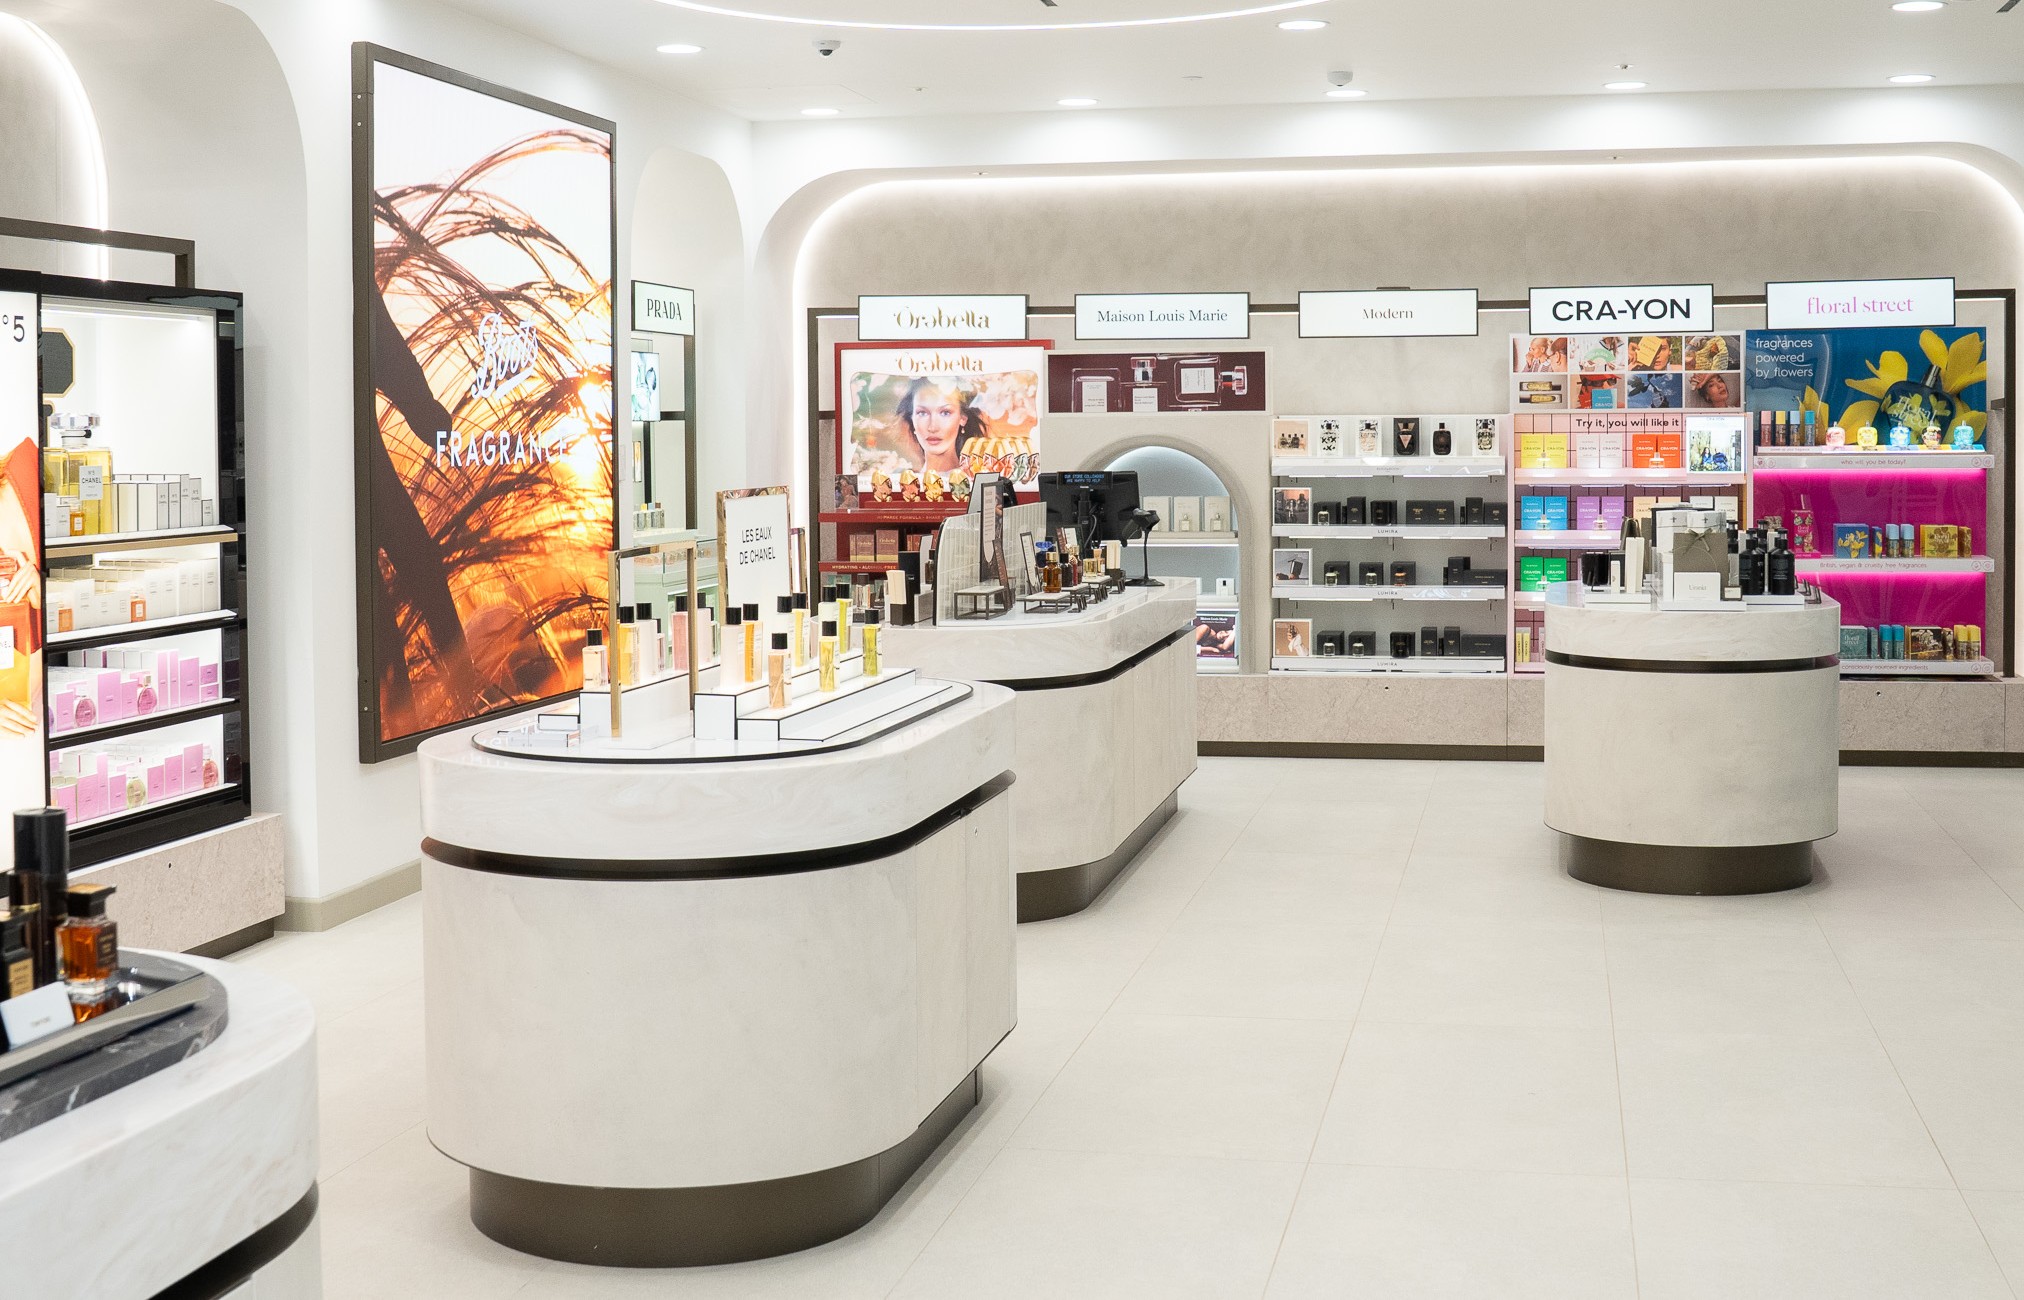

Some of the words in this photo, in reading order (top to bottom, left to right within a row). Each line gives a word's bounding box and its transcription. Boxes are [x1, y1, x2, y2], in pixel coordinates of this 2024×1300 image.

[647, 298, 682, 321] PRADA
[1363, 308, 1413, 319] Modern
[1552, 298, 1691, 322] CRA-YON
[1807, 296, 1857, 314] floral
[1863, 298, 1914, 313] street
[1097, 310, 1145, 322] Maison
[1150, 309, 1185, 322] Louis
[1189, 309, 1228, 322] Marie
[1755, 337, 1813, 351] fragrances
[471, 312, 539, 399] Boots
[1755, 352, 1804, 365] powered
[1755, 367, 1770, 380] by
[1774, 366, 1814, 377] flowers
[1576, 418, 1592, 430] Try
[1595, 418, 1605, 429] it,
[1608, 420, 1627, 430] you
[1631, 418, 1648, 427] will
[1651, 418, 1668, 427] like
[1672, 418, 1679, 427] it
[436, 430, 569, 468] FRAGRANCE
[741, 528, 754, 544] LES
[755, 526, 772, 541] EAUX
[739, 551, 749, 565] DE
[750, 546, 776, 563] CHANEL
